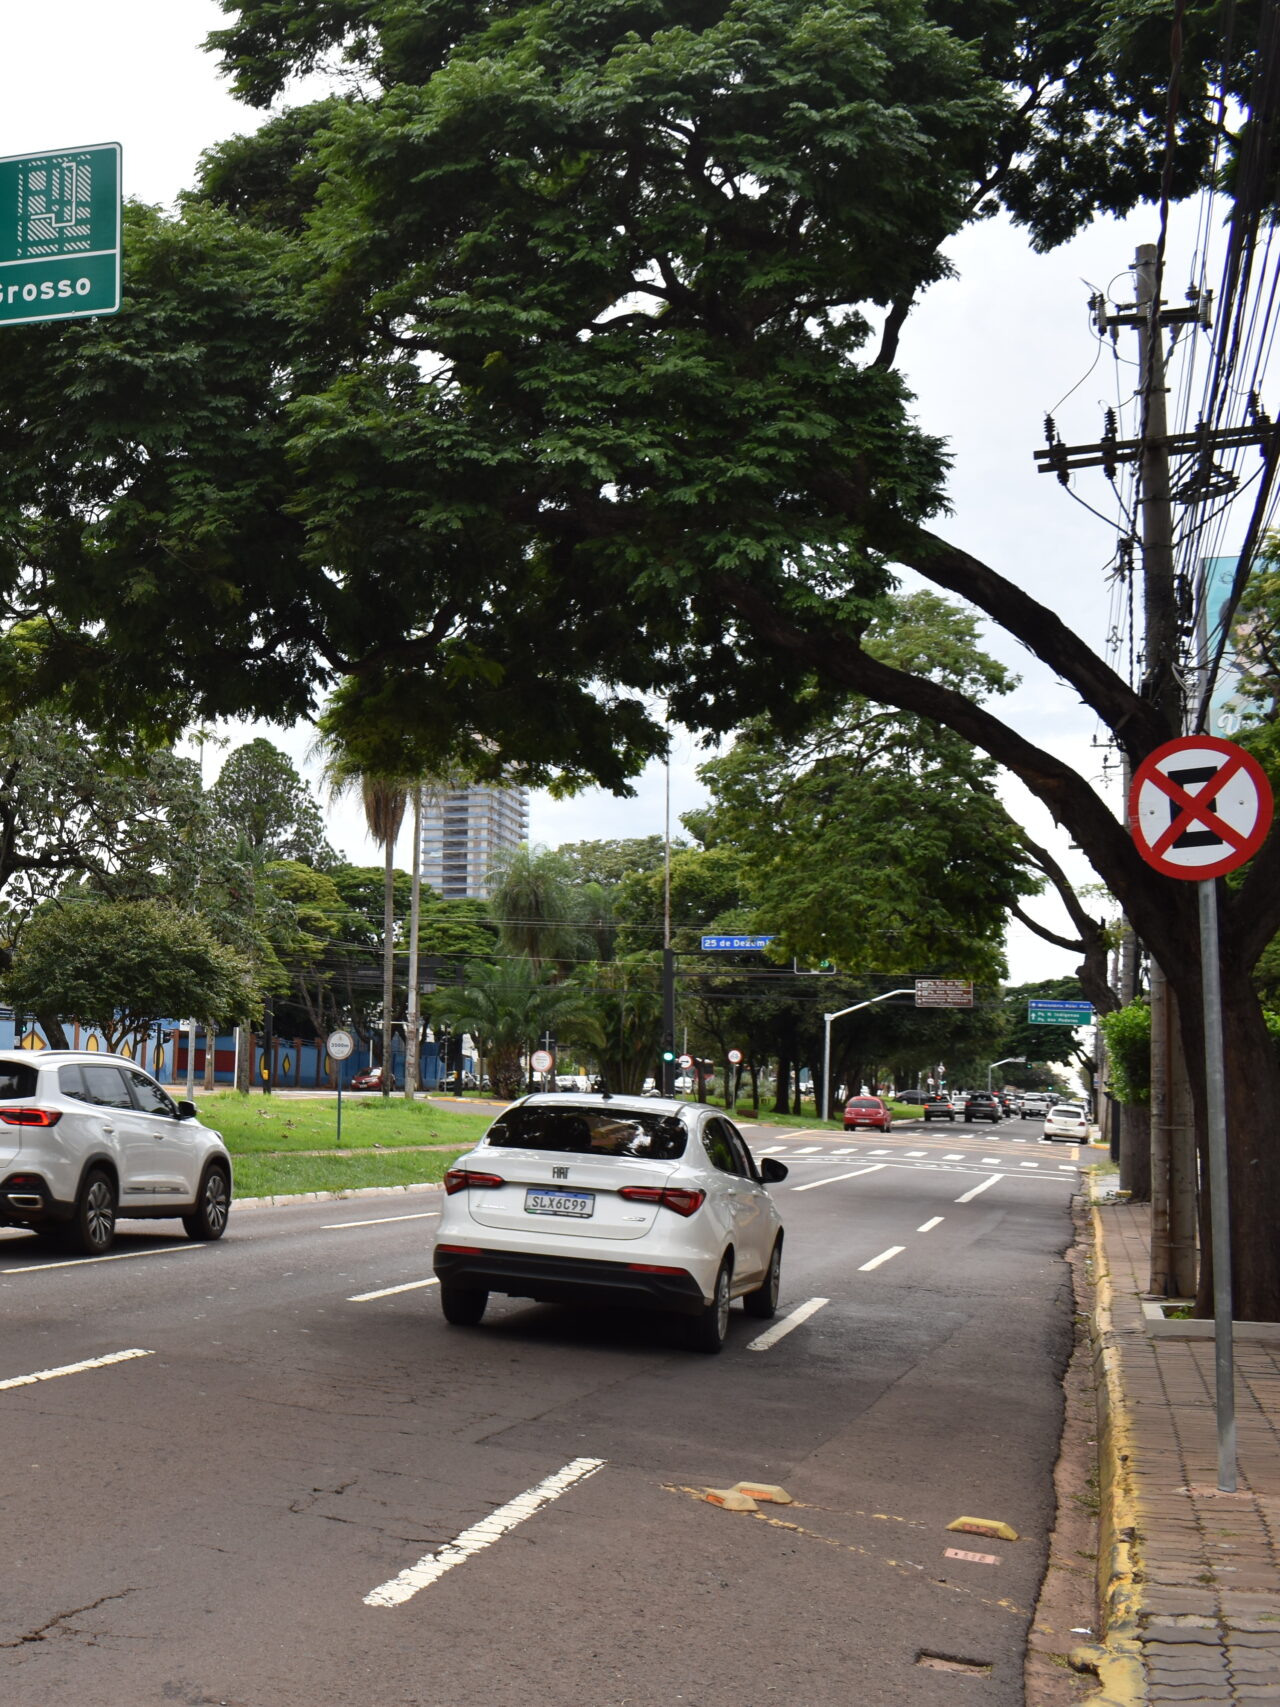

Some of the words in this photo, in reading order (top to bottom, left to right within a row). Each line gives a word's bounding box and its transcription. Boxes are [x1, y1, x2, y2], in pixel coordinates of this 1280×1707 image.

[704, 939, 717, 947] 25
[720, 939, 731, 947] de
[552, 1166, 570, 1180] FIAT
[531, 1196, 587, 1212] SLX6C99
